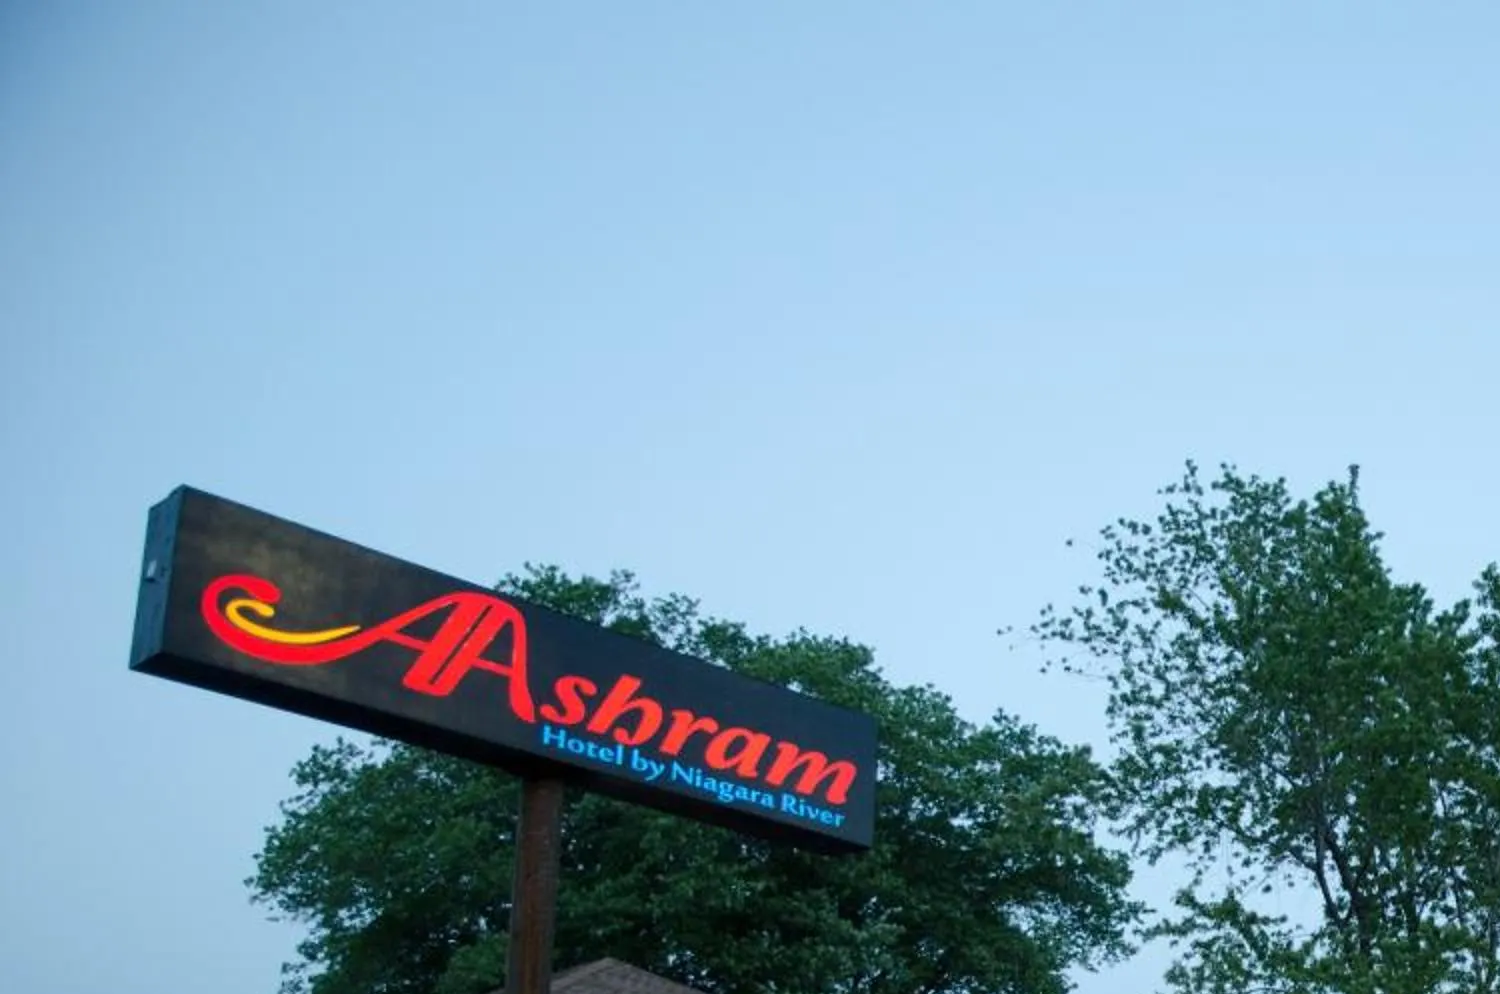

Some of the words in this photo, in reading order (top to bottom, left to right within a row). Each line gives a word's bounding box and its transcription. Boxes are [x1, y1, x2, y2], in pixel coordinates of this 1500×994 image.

[542, 724, 625, 766] Hotel
[631, 747, 665, 782] by
[671, 761, 775, 804] Niagara
[780, 792, 846, 828] River
